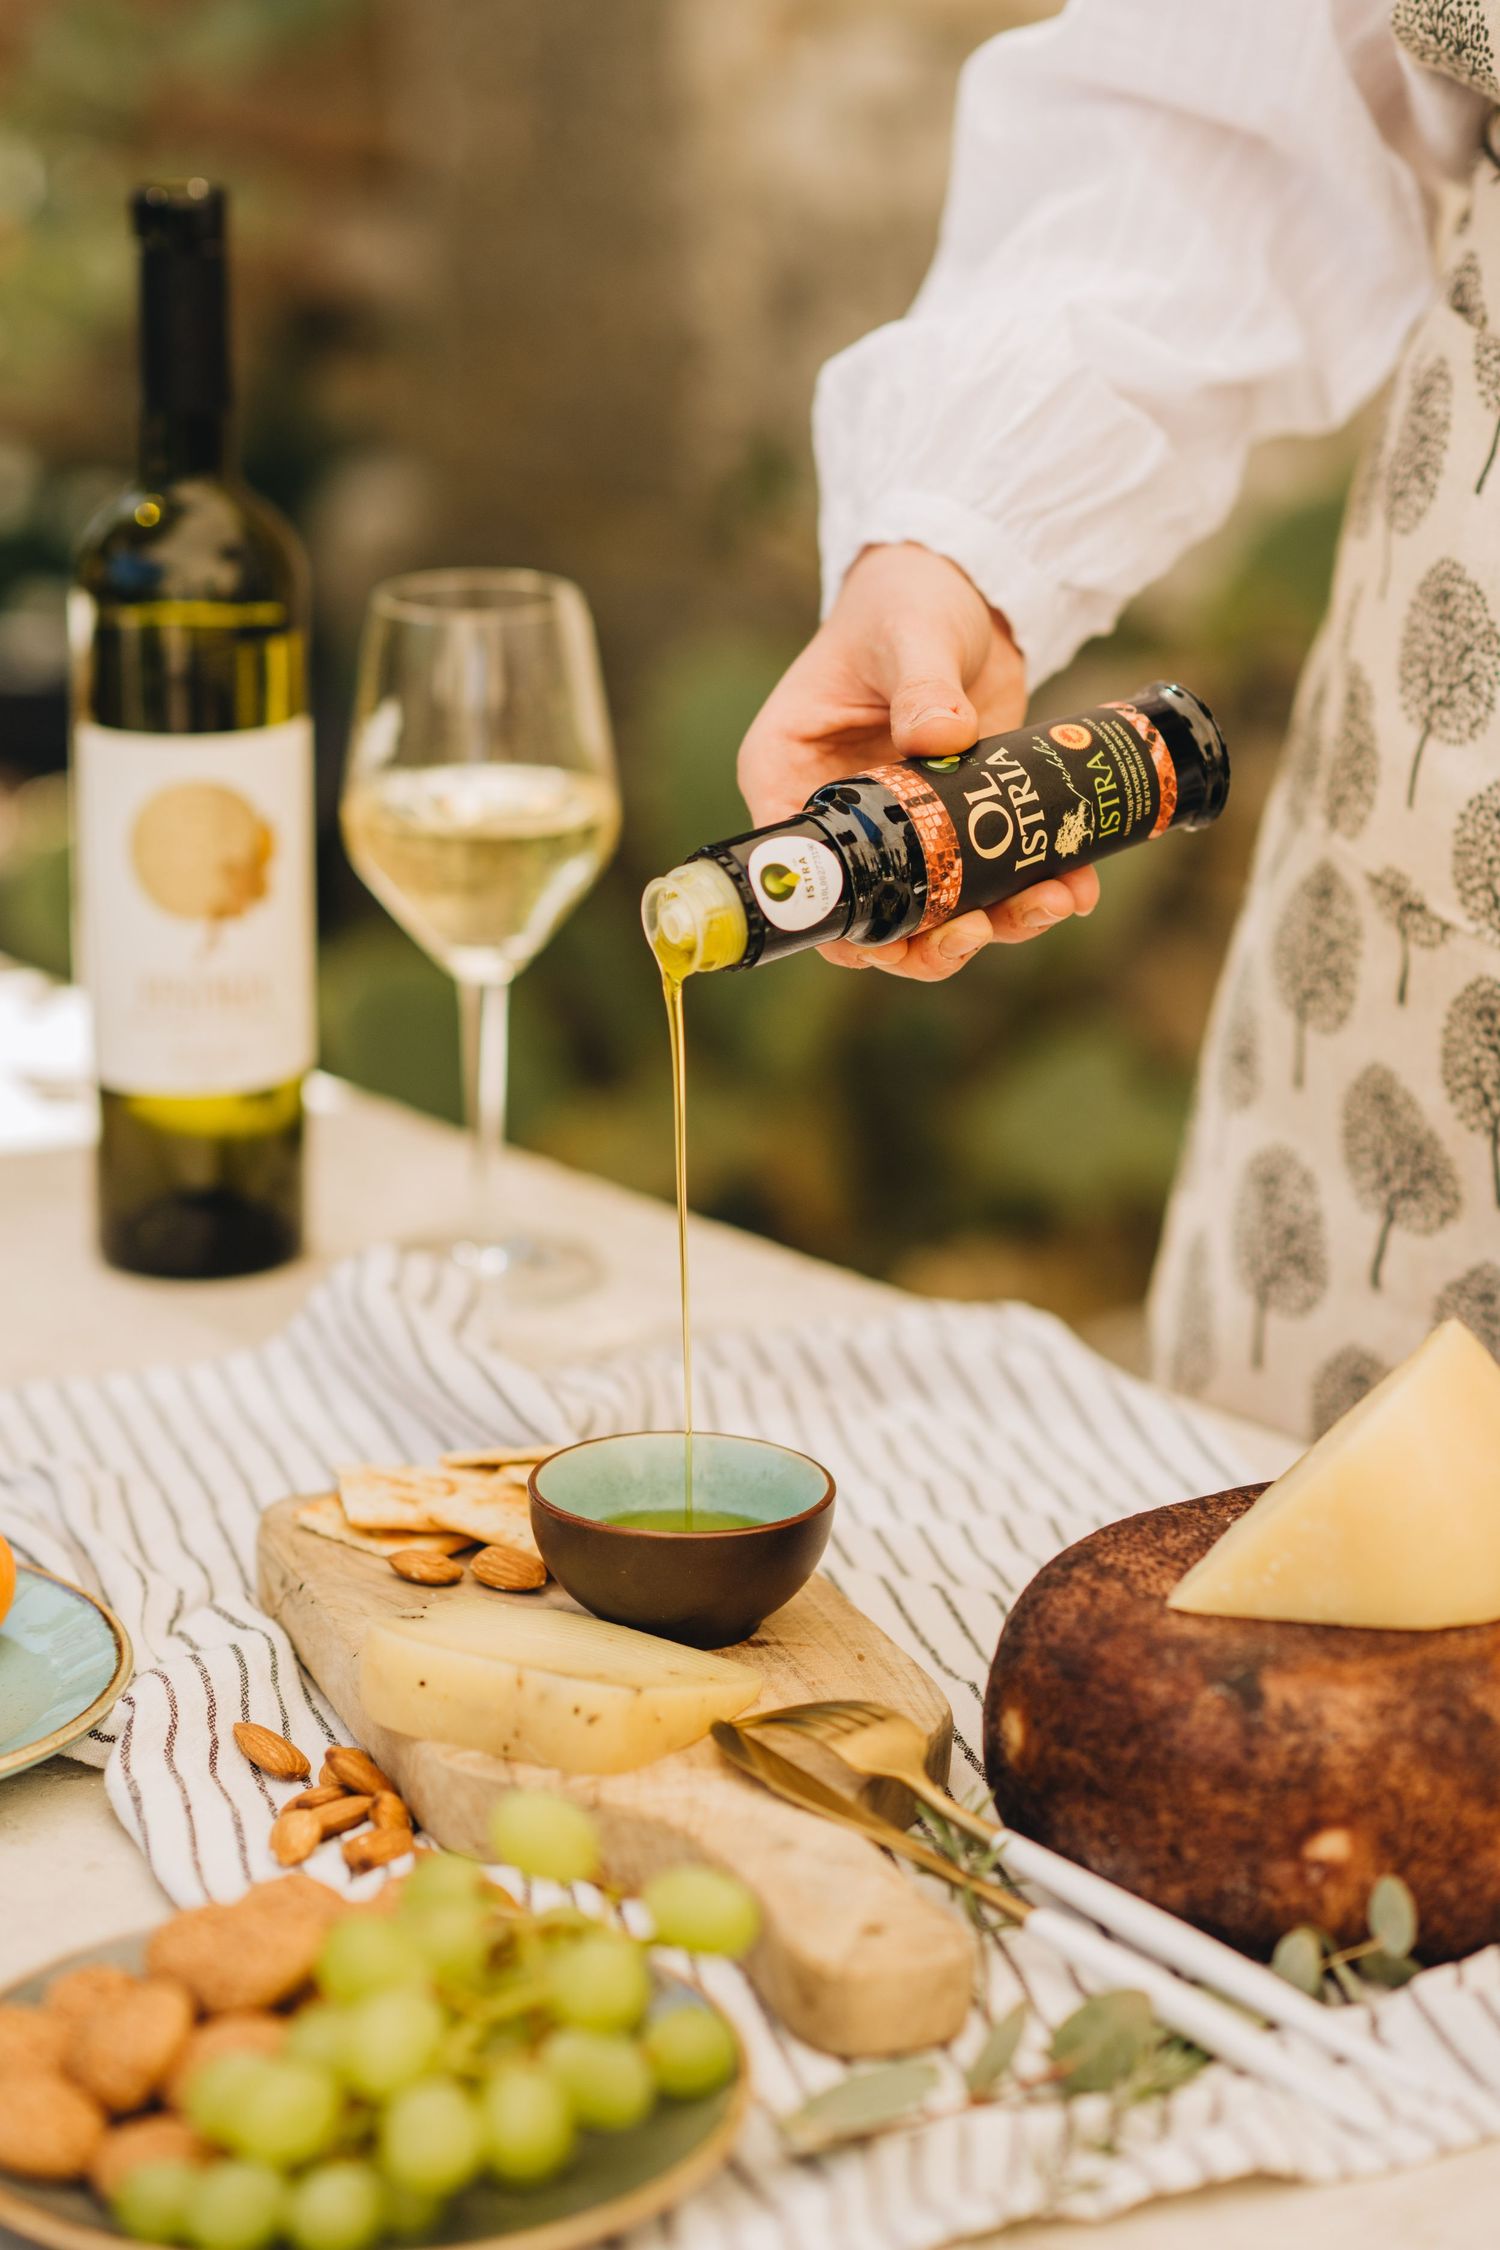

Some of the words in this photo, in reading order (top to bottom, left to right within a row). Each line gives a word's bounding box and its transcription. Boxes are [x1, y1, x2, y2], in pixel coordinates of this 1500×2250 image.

[963, 771, 1014, 860] OL
[1086, 750, 1121, 839] ISTRA
[799, 857, 815, 899] ISTRA
